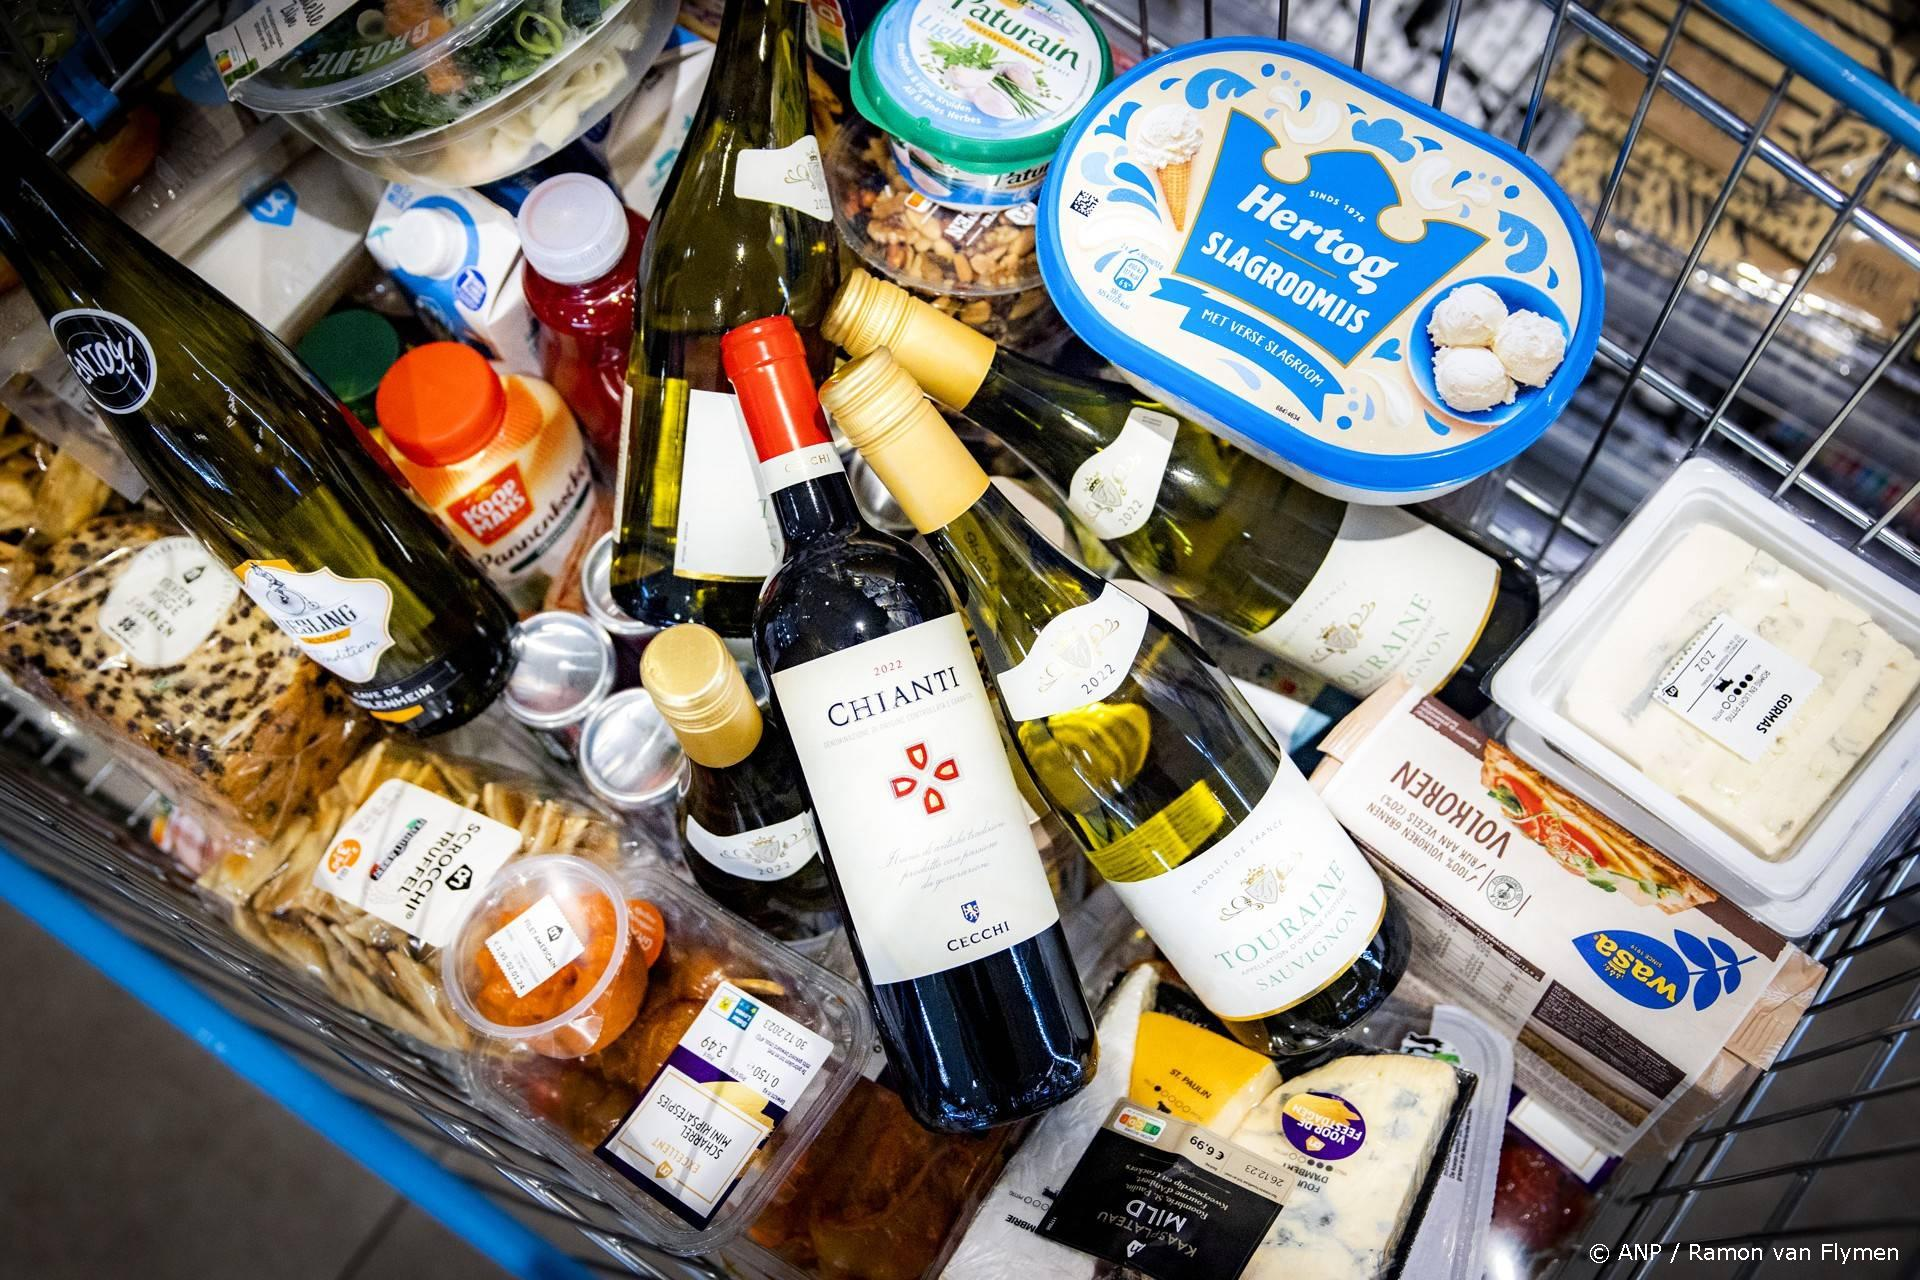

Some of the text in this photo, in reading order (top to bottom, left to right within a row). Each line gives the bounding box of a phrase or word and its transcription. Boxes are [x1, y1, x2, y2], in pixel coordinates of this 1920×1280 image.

[302, 19, 430, 78] GROENTE
[946, 111, 982, 126] Herbes
[1308, 189, 1366, 224] SINDS 1976
[1237, 183, 1400, 295] Hertog
[1201, 231, 1371, 334] SLAGROOMIJS
[1202, 308, 1326, 389] MET VERSE SLAGROOM
[784, 452, 831, 473] CCHI
[462, 479, 517, 527] KOOP
[471, 490, 527, 539] MANS
[1117, 500, 1145, 528] 2022
[1338, 593, 1432, 687] OURAINE
[873, 659, 904, 677] 2022
[1080, 663, 1117, 696] 2022
[386, 685, 403, 698] DE
[828, 665, 961, 727] CHIANTI
[1756, 692, 1793, 735] GORMAS
[1366, 801, 1404, 832] GRANEN
[1390, 760, 1513, 860] VOLKOREN
[1405, 811, 1438, 840] VEZELS
[1249, 818, 1284, 846] FRANCE
[1400, 827, 1445, 864] VOLKOREN
[1438, 834, 1460, 852] AAN
[397, 831, 455, 894] TRUFFEL
[756, 861, 792, 876] 2022
[1447, 856, 1469, 880] 100%
[1460, 848, 1479, 870] RIJK
[1214, 860, 1345, 970] TOURAINE
[947, 921, 1011, 952] CECCHI
[1256, 905, 1359, 993] SAUVIGNON
[1593, 932, 1679, 1005] wasa
[1644, 954, 1664, 969] SINCE
[700, 1035, 728, 1058] 3.49
[762, 1019, 808, 1051] 30.12.2023
[752, 1065, 780, 1088] 0.150
[1169, 1067, 1213, 1100] ST. PAULIN
[1291, 1104, 1364, 1142] FEESTDAGEN
[1296, 1118, 1347, 1147] VOOR DE
[650, 1136, 702, 1175] EXCELLENT
[680, 1125, 725, 1161] SCHARREL
[711, 1130, 732, 1150] MINI
[1189, 1135, 1226, 1161] € 6.99
[1125, 1163, 1230, 1212] Kweepeerdip en Crackers
[1244, 1163, 1285, 1189] 26.12.23
[1125, 1199, 1188, 1234] MILD
[1165, 1195, 1210, 1221] Roombrie,
[1175, 1190, 1209, 1211] Fourme
[1096, 1210, 1198, 1258] KAASPLATEAU
